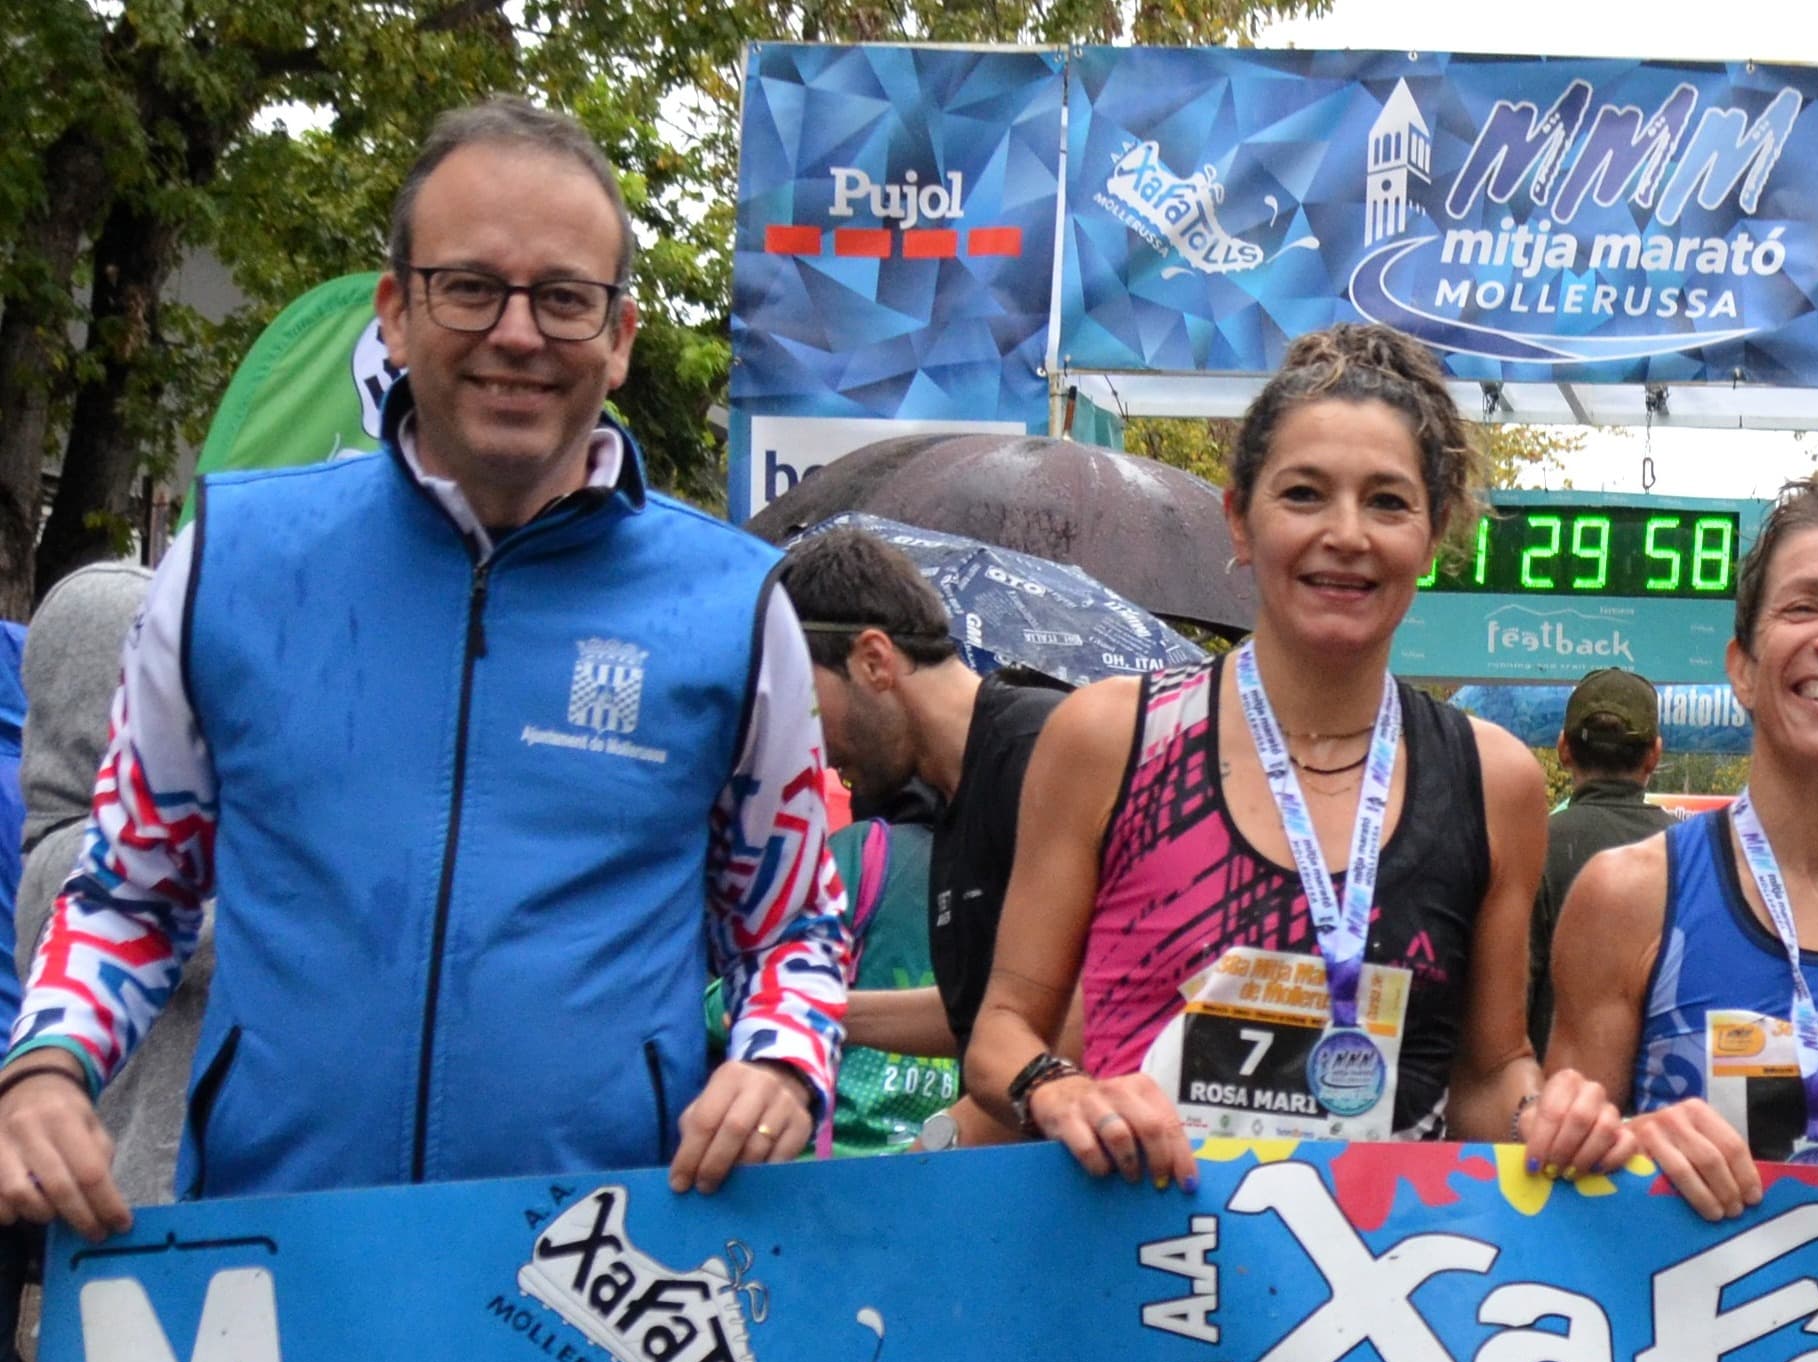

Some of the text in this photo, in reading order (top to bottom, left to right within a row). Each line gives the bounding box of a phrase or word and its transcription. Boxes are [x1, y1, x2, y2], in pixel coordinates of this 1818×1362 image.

[829, 167, 964, 231] Pujol
[1440, 216, 1787, 278] mitja marató
[1434, 278, 1738, 319] MOLLERUSSA
[1520, 515, 1611, 589] 29
[1644, 516, 1733, 590] 58
[1657, 685, 1746, 728] fatolls
[1238, 1028, 1275, 1077] 7
[1189, 1081, 1249, 1107] ROSA
